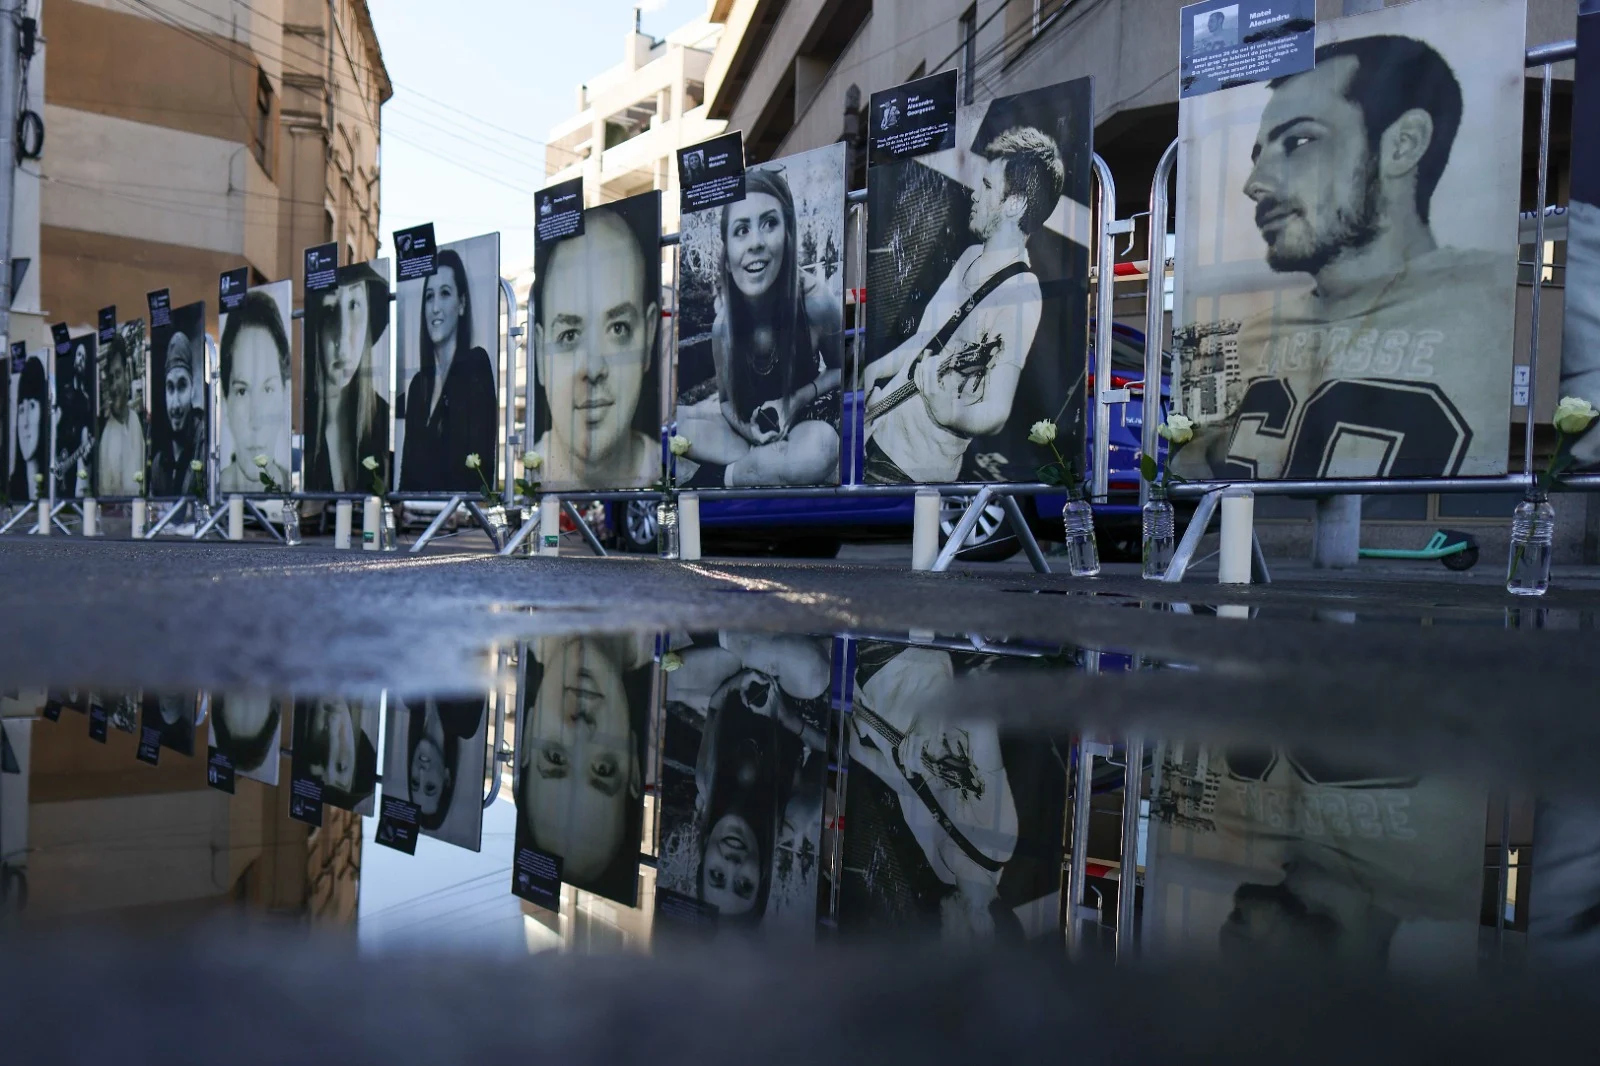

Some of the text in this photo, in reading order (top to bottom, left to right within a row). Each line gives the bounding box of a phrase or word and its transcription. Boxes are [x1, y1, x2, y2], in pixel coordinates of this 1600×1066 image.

[1250, 9, 1272, 20] Matei
[1249, 14, 1290, 28] Alexandru
[1192, 56, 1208, 64] Matei
[907, 98, 934, 110] Alexandru
[908, 95, 920, 104] Paul
[906, 104, 936, 116] Georgescu
